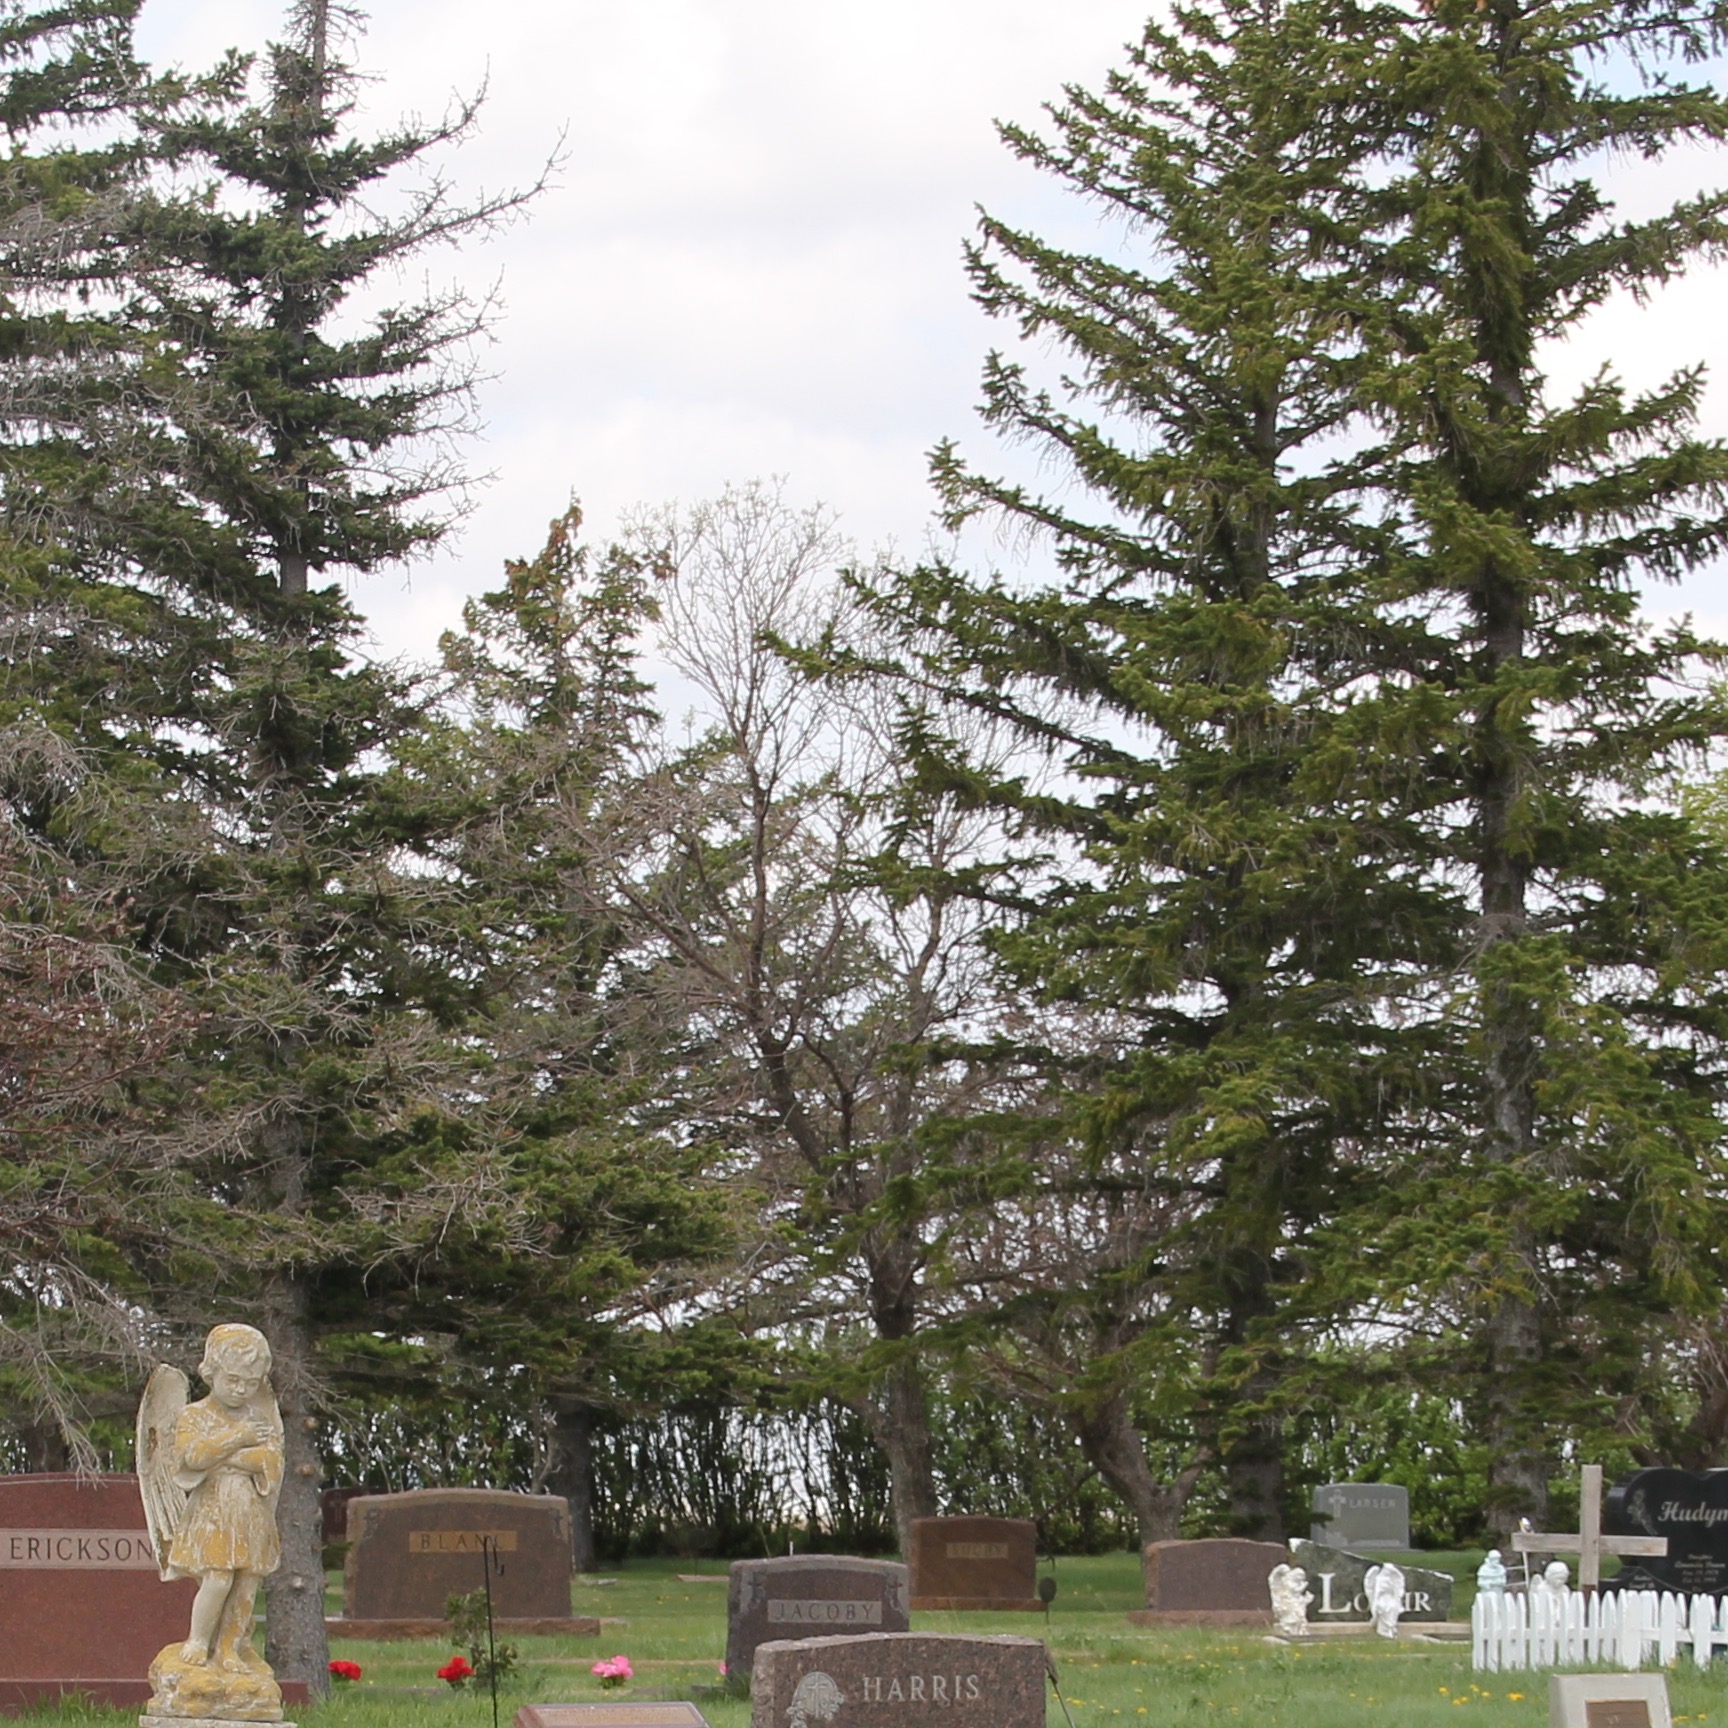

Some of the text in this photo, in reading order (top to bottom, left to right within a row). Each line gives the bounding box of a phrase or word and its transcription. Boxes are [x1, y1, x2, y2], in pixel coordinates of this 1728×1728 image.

[10, 1537, 153, 1561] ERICKSON
[1317, 1572, 1432, 1614] LOIR
[774, 1603, 873, 1620] JACOBY
[863, 1674, 980, 1701] HARRIS
